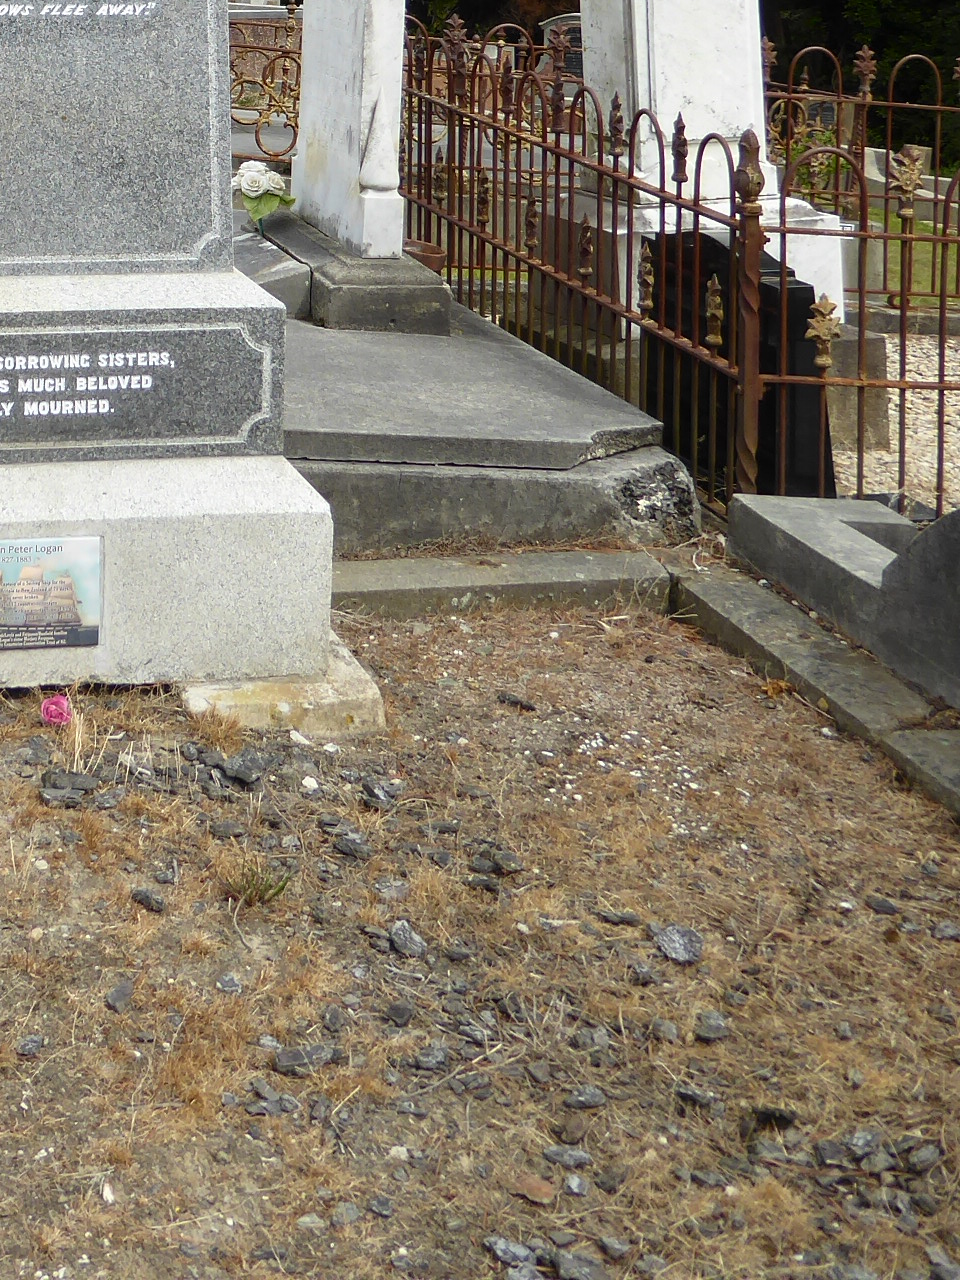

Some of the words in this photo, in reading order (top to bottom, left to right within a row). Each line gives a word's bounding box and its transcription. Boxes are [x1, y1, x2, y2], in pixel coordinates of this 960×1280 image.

[40, 4, 88, 16] FLEE
[98, 352, 175, 368] SISTERS,
[18, 378, 65, 393] MUCH
[76, 376, 152, 391] BELOVED
[24, 399, 114, 415] MOURNED.
[35, 545, 63, 554] Logan
